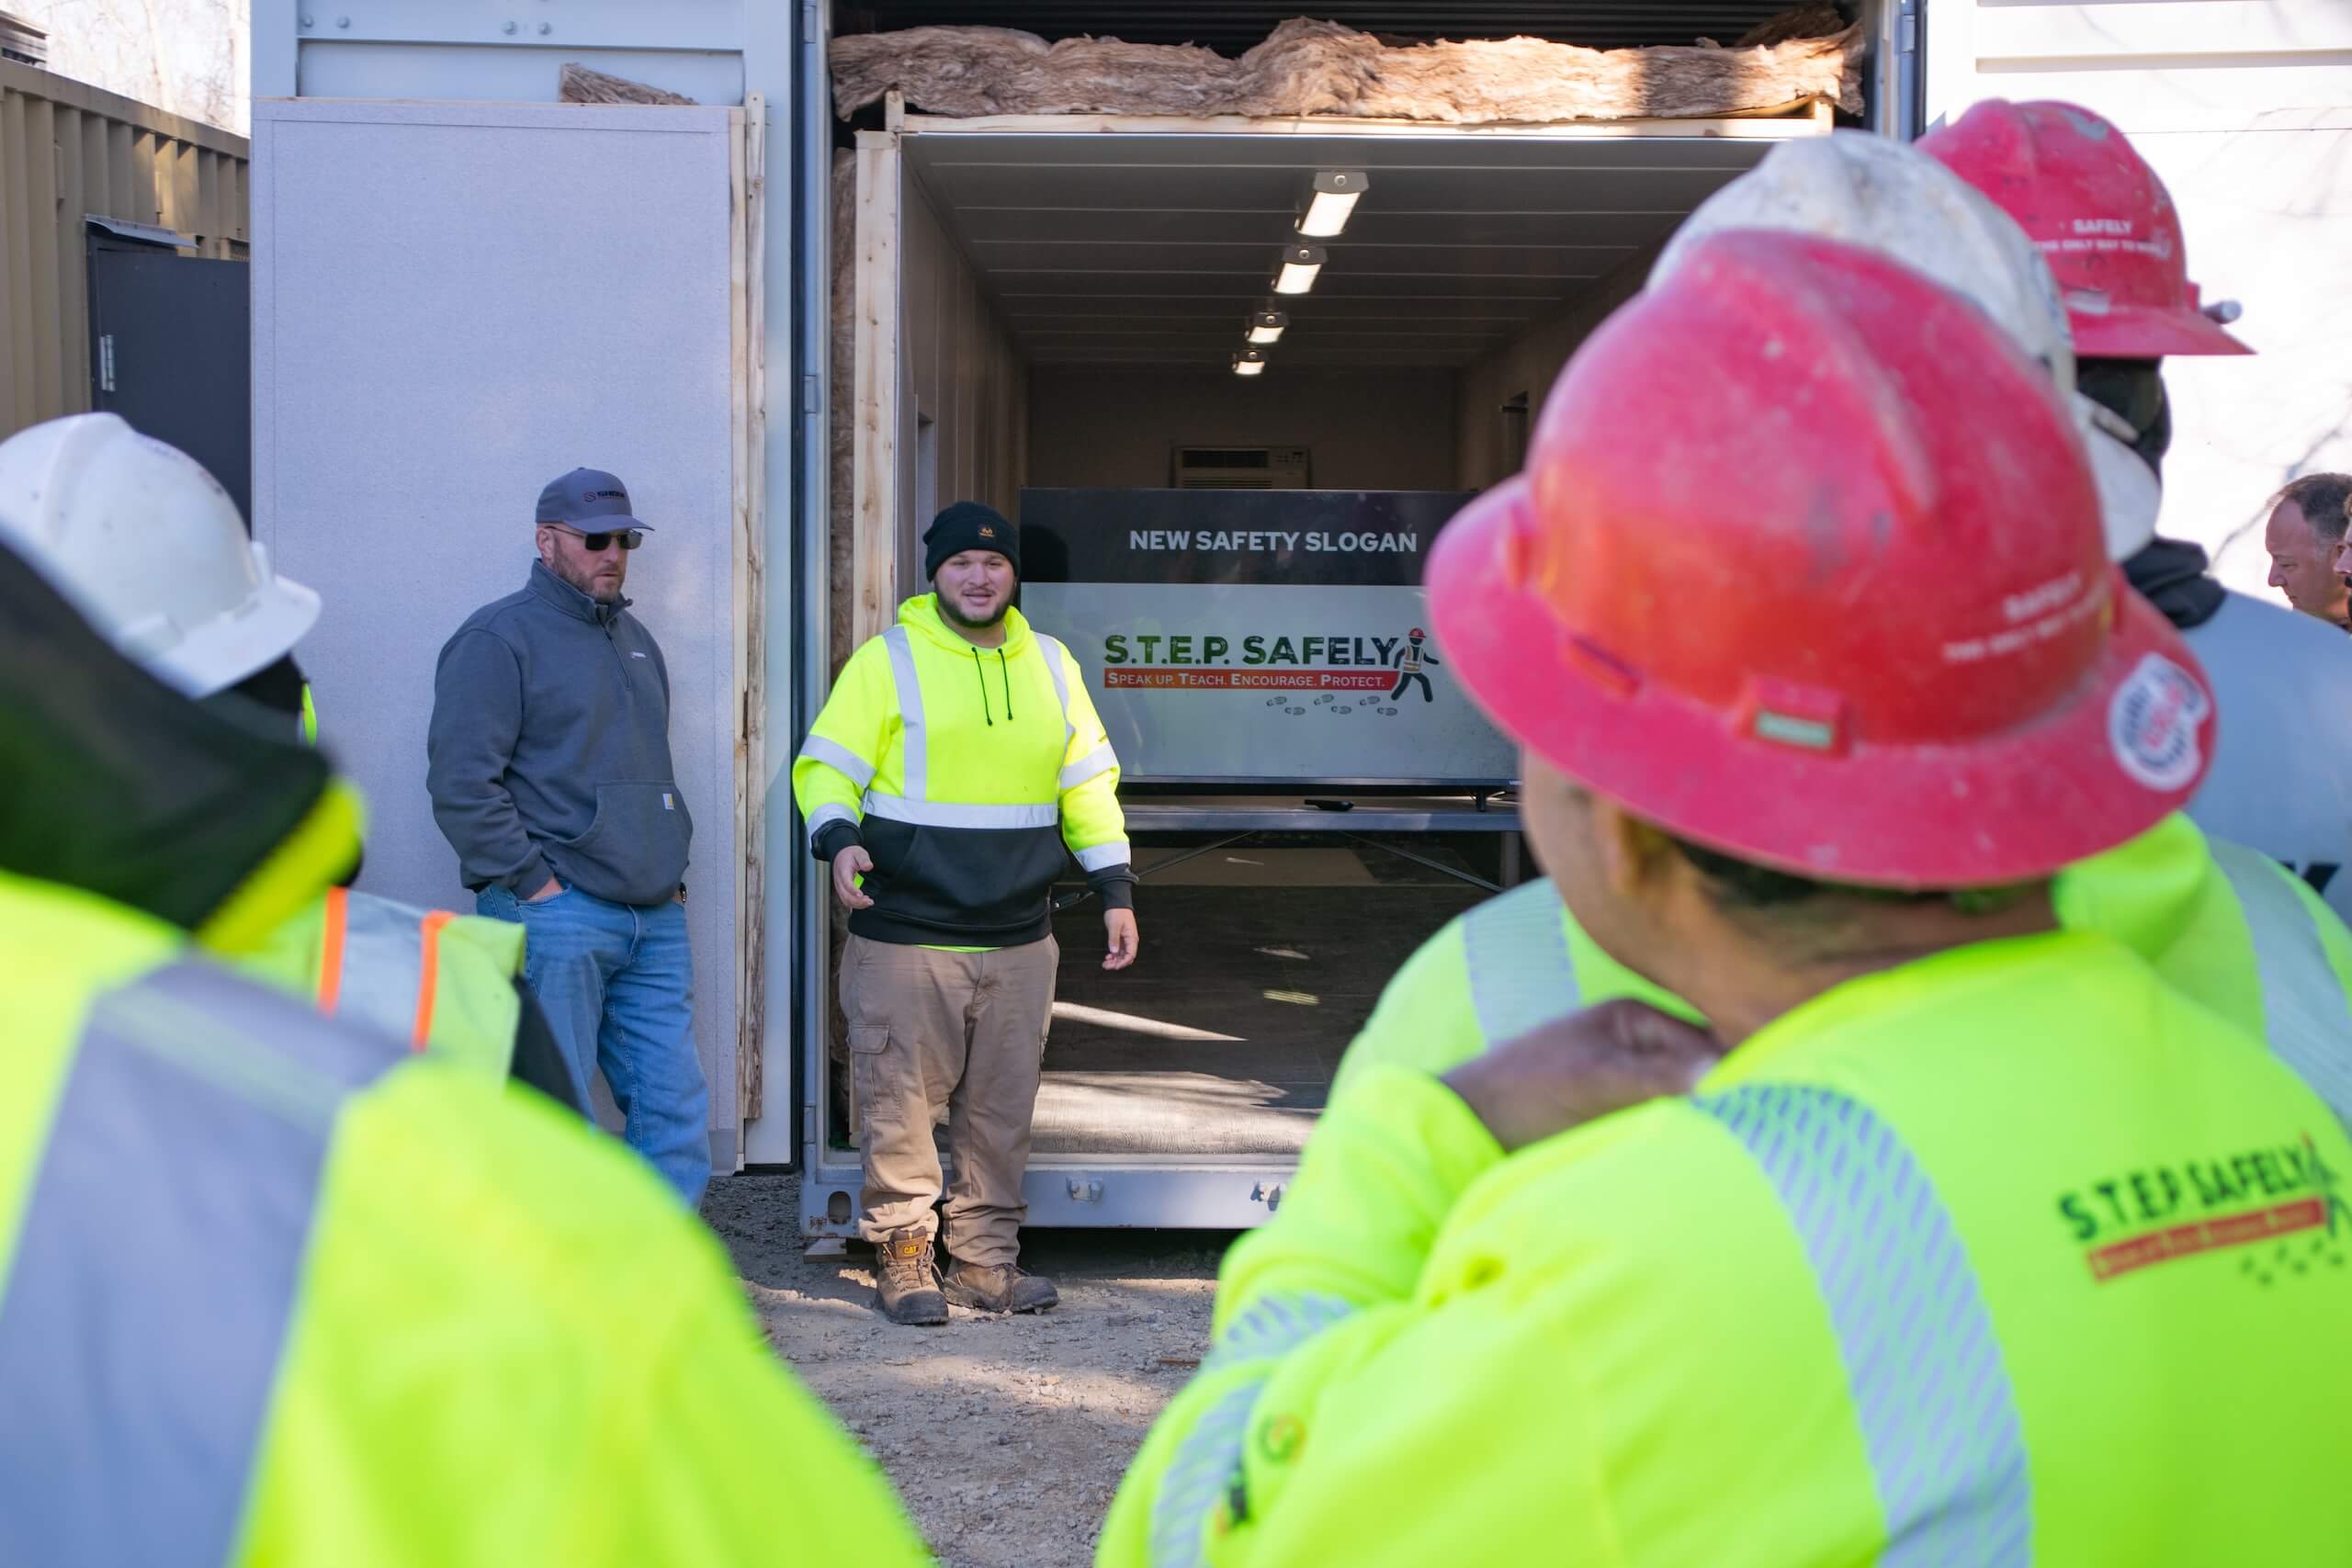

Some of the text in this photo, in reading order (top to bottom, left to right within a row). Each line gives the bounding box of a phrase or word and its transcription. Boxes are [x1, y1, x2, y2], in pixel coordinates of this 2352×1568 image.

[2073, 219, 2132, 234] SAFELY
[1130, 530, 1417, 552] NEW SAFETY SLOGAN
[1104, 635, 1399, 665] S.T.E.P. SAFELY
[904, 1246, 918, 1254] CAT
